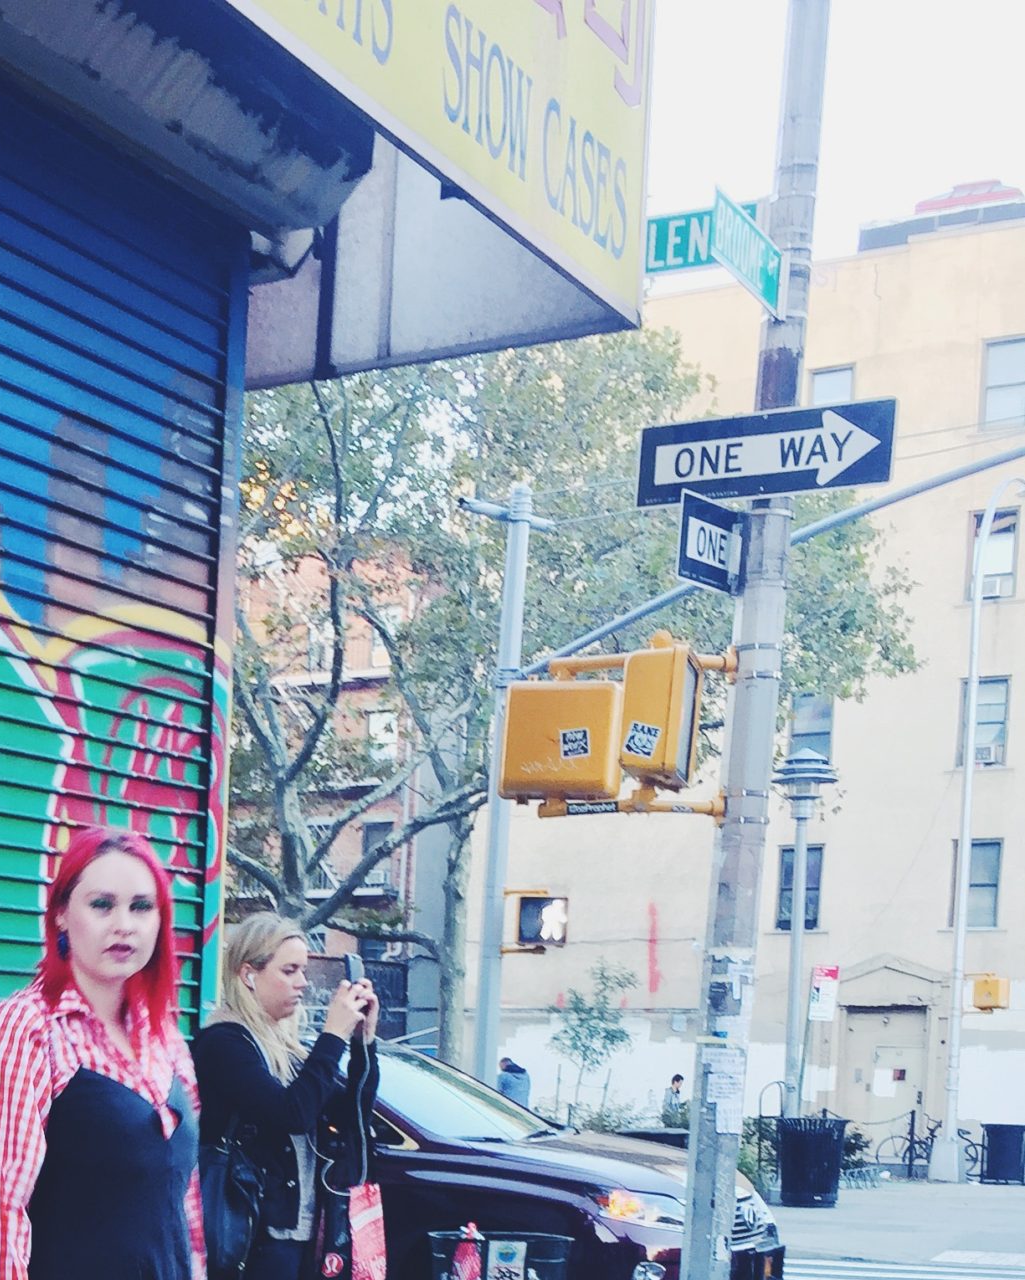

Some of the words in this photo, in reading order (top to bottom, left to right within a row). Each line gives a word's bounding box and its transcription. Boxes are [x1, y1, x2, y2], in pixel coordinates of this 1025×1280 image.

[442, 4, 533, 183] SHOW
[542, 97, 628, 260] CASES
[675, 442, 743, 479] ONE
[779, 430, 854, 469] WAY
[697, 526, 728, 566] ONE
